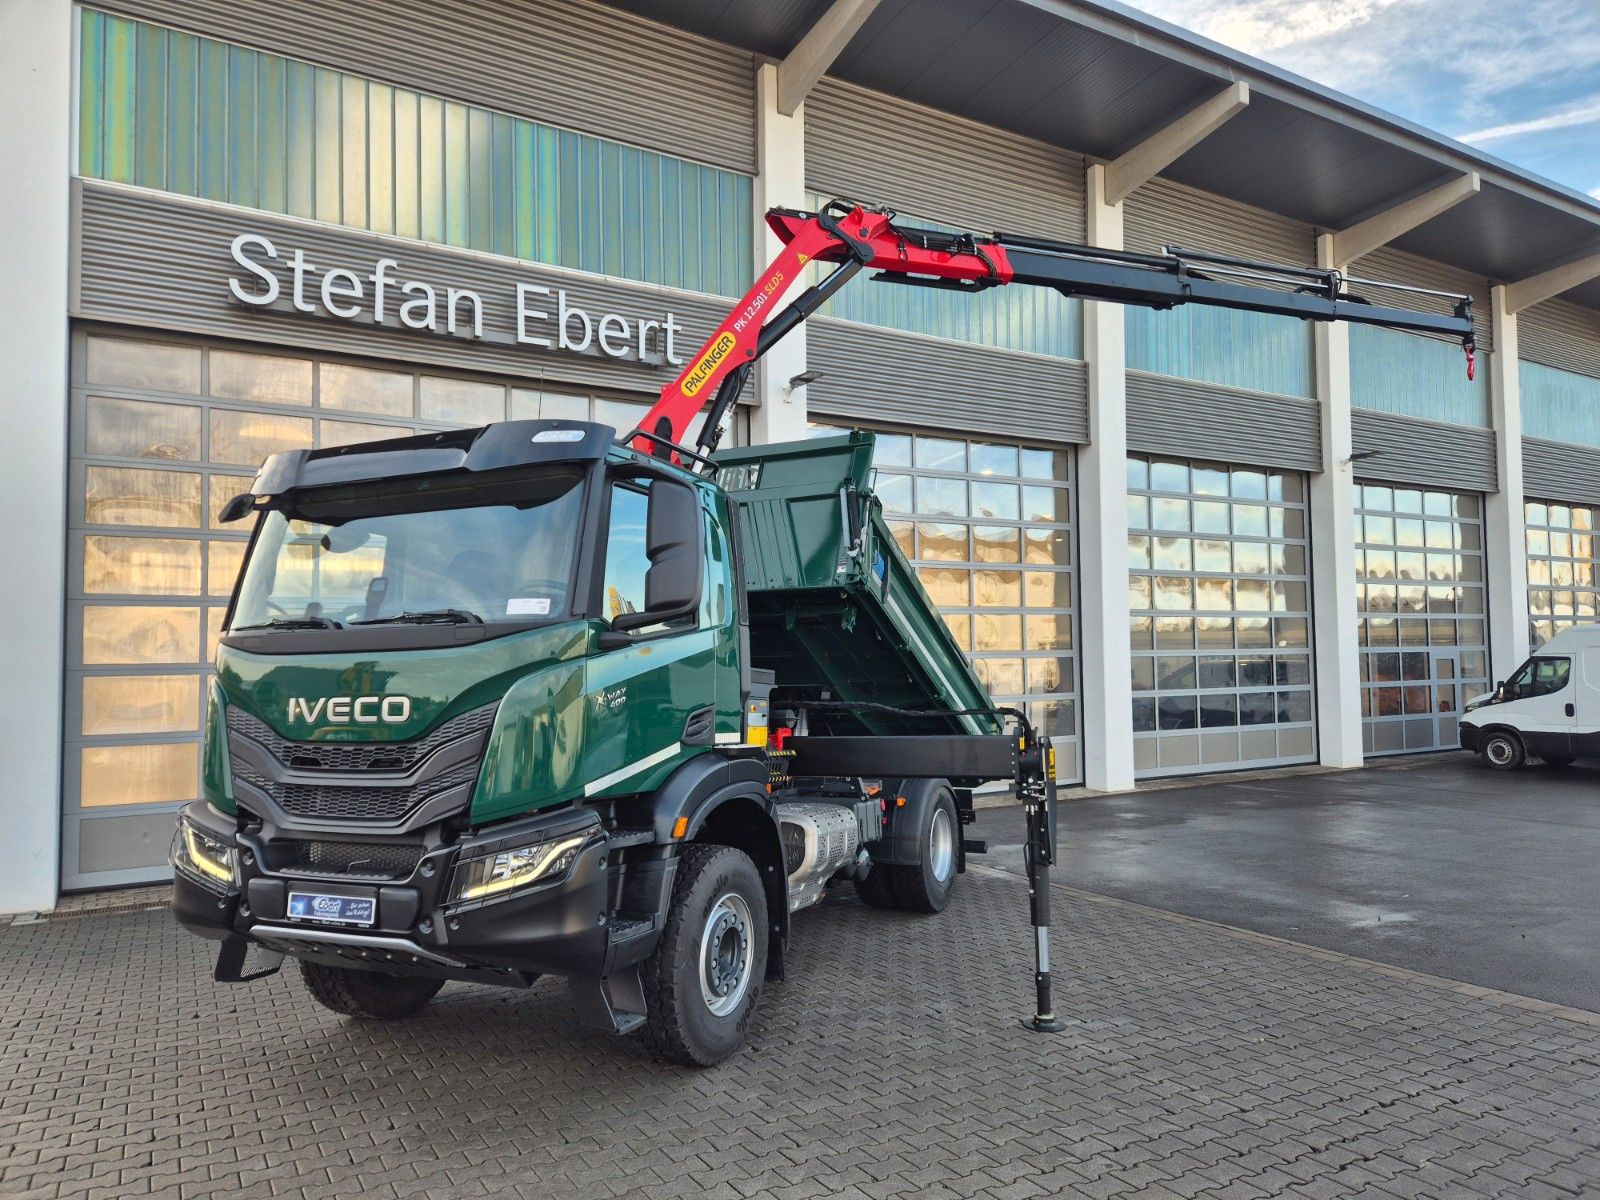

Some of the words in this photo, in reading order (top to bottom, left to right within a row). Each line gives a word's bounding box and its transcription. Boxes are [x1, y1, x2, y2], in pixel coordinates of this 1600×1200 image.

[229, 233, 483, 337] Stefan
[516, 282, 683, 365] Ebert
[733, 315, 748, 332] PK
[743, 292, 768, 320] 12.501
[764, 271, 784, 295] SLD5
[684, 335, 734, 393] PALFINGER
[288, 696, 410, 723] IVECO
